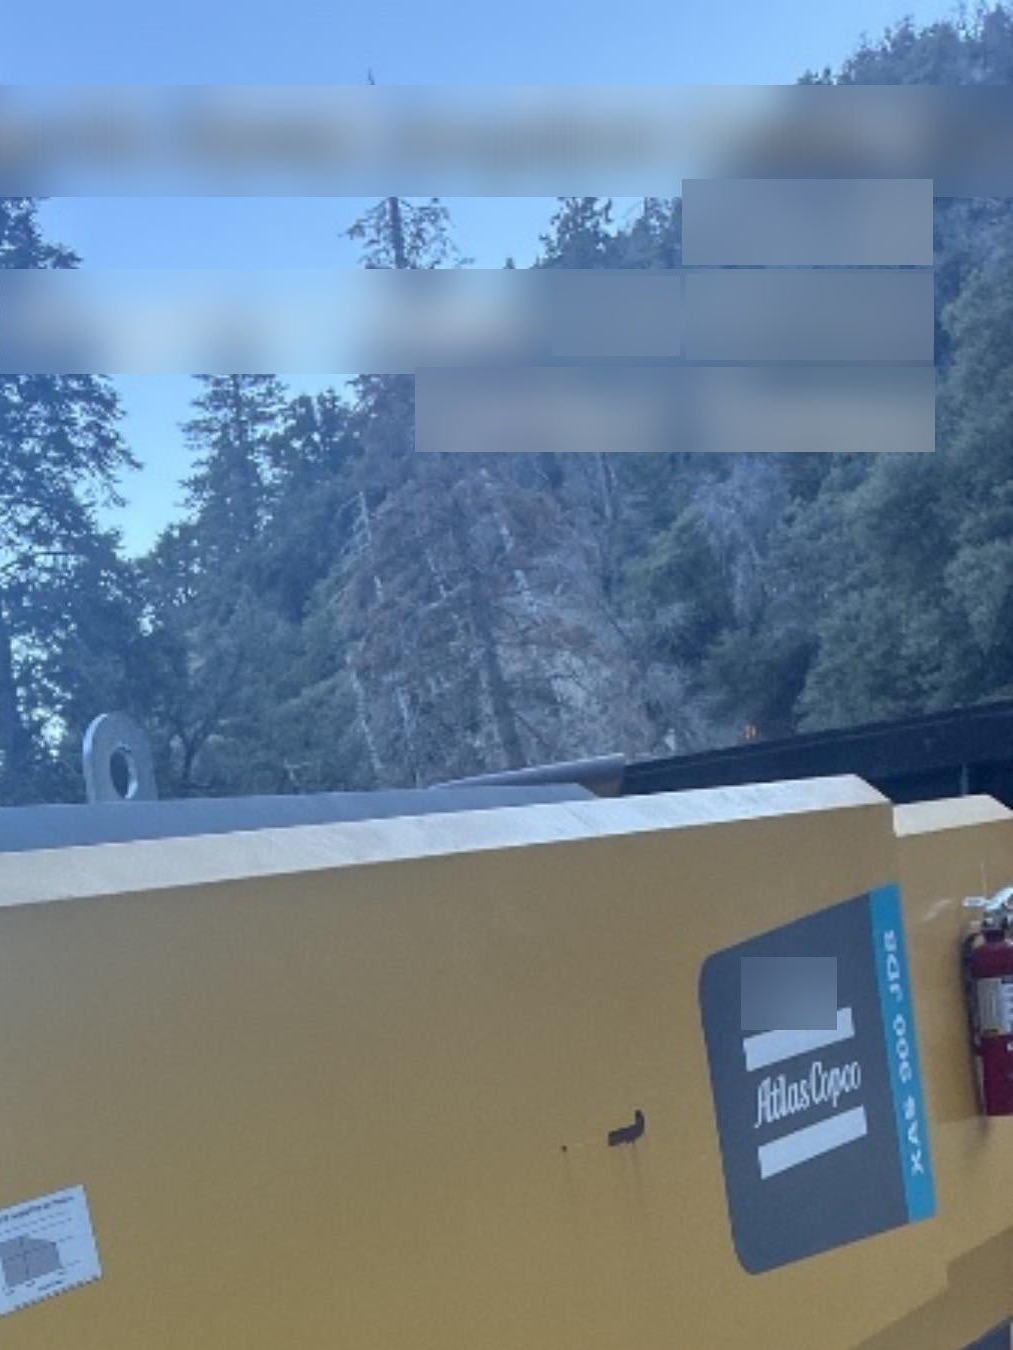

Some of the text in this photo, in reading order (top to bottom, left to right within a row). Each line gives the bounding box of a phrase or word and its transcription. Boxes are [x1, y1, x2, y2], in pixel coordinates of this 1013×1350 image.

[893, 1014, 913, 1084] 900
[753, 1061, 862, 1128] Atlas Copco
